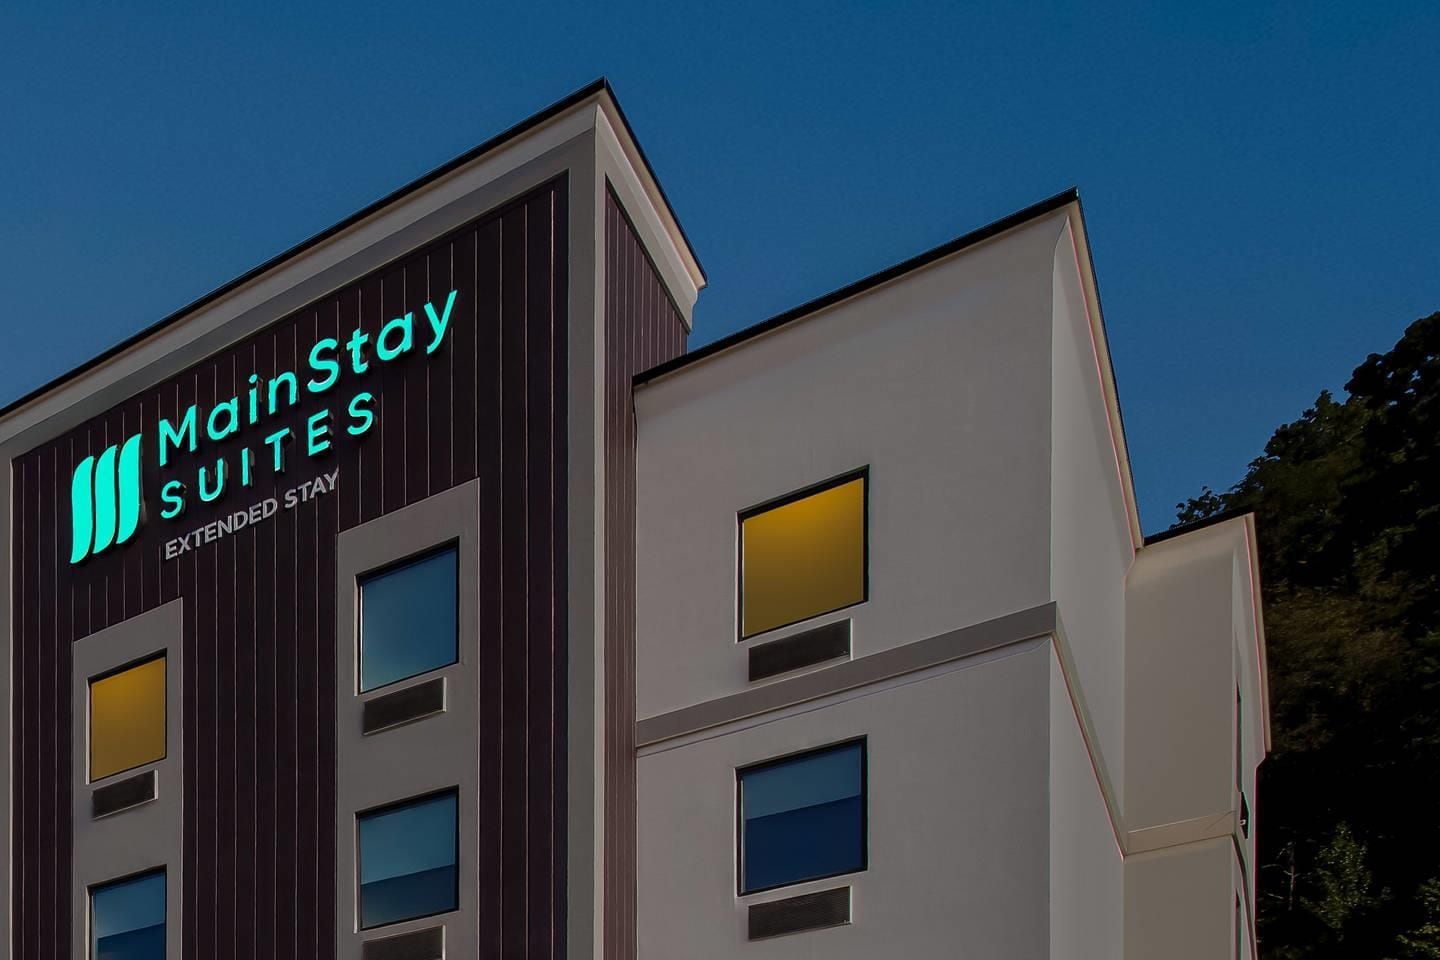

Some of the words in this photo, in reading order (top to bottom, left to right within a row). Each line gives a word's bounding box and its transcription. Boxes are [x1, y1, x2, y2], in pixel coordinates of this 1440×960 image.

[158, 289, 458, 467] MainStay
[160, 391, 377, 520] SUITES
[164, 498, 278, 561] EXTENDED
[284, 468, 340, 512] STAY
